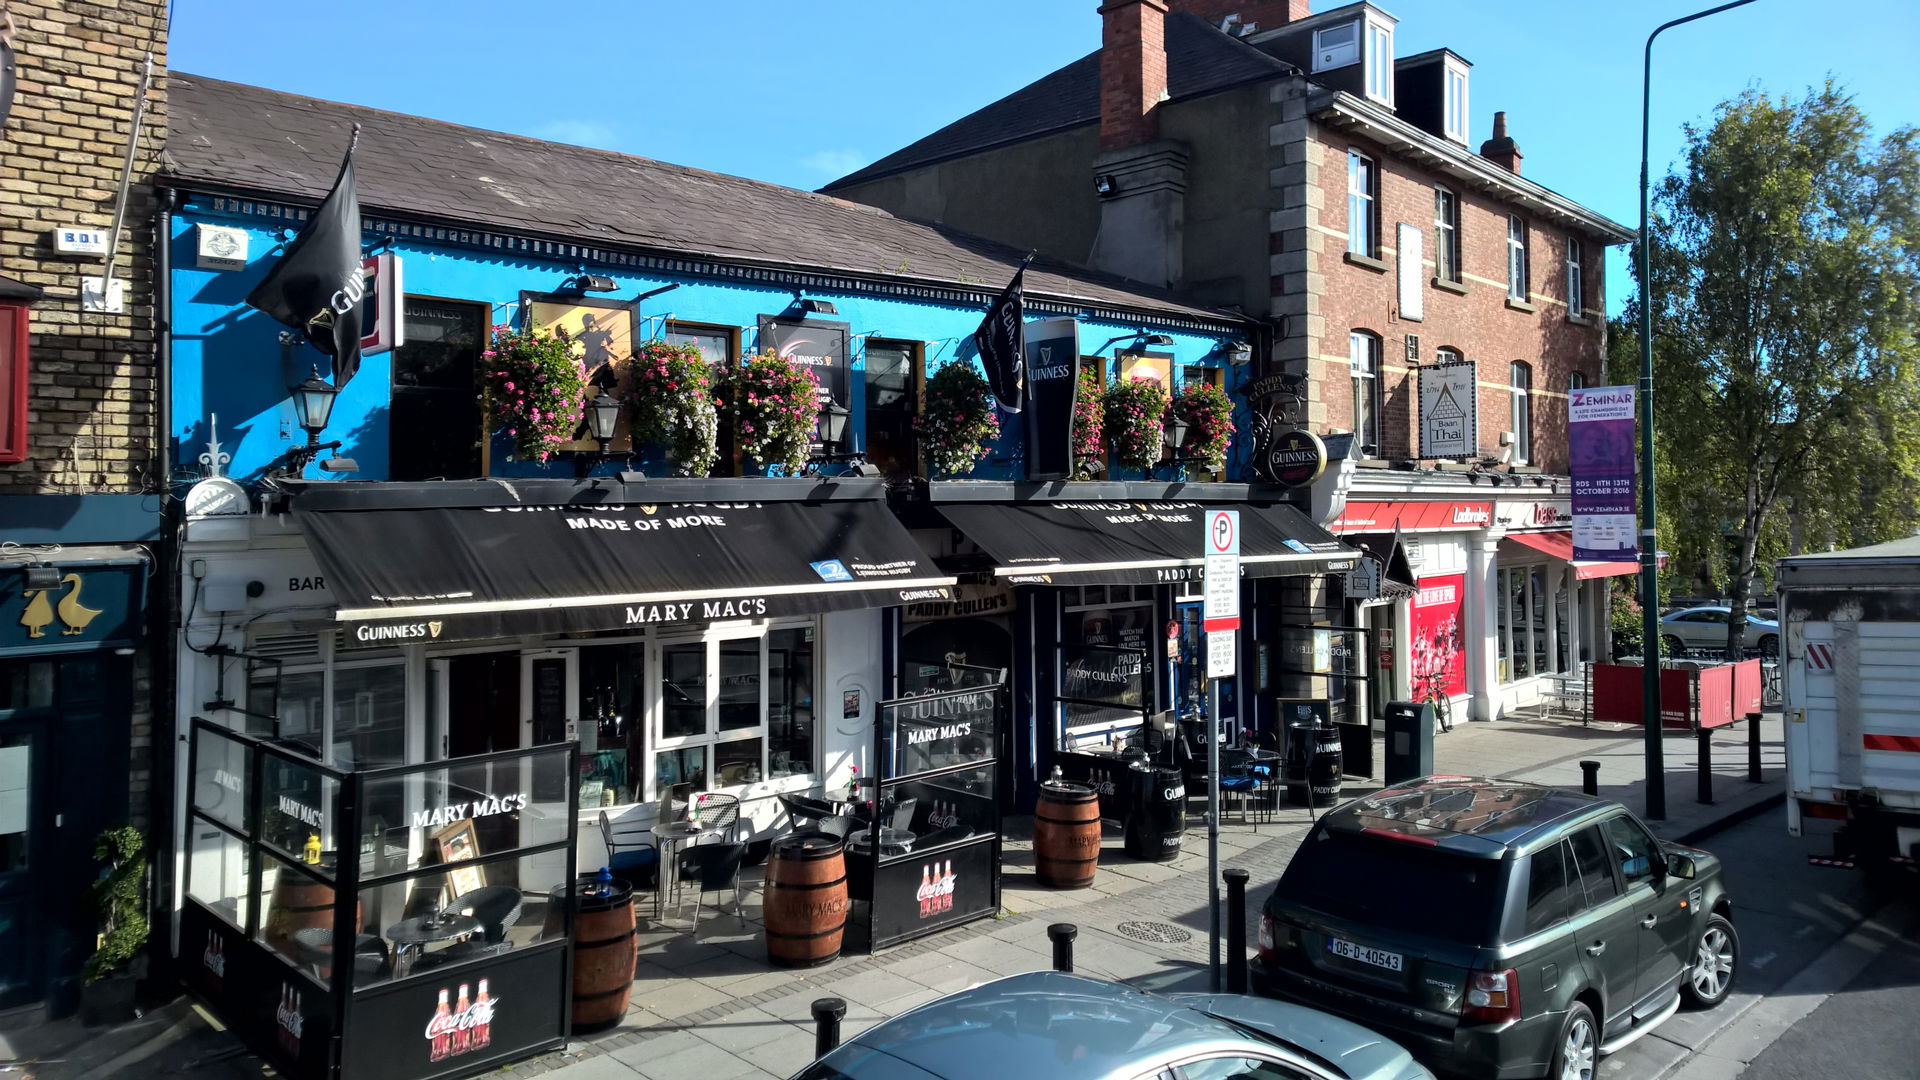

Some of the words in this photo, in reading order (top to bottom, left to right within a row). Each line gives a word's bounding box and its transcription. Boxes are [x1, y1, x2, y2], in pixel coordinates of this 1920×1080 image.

[1572, 393, 1632, 407] ZEMINAR
[1438, 420, 1458, 428] Baan
[1432, 429, 1462, 440] Thai
[1272, 450, 1317, 463] GUINNESS
[566, 518, 632, 531] MADE
[633, 519, 662, 531] OF
[665, 515, 726, 529] MORE
[1105, 514, 1144, 524] MADE
[1157, 514, 1193, 523] MORE
[1453, 507, 1489, 523] Ladbrokes
[1219, 520, 1228, 544] P
[1158, 567, 1192, 581] PADDY
[288, 576, 326, 592] BAR
[900, 589, 940, 601] GUINNESS
[626, 603, 694, 623] MARY
[703, 598, 766, 618] MAC'S
[908, 601, 951, 617] PADDY
[953, 594, 1008, 616] CULLEN'S
[357, 623, 426, 641] GUINNESS
[1118, 653, 1146, 665] PADD
[1066, 668, 1091, 680] PADDY
[1092, 671, 1128, 683] CULLEN'S
[908, 728, 939, 745] MARY
[940, 723, 971, 739] MAC'S
[279, 795, 301, 819] MARY
[300, 804, 324, 829] MAC'S
[412, 802, 469, 829] MARY
[472, 793, 527, 818] MAC'S
[1336, 941, 1399, 970] 06-D-40543
